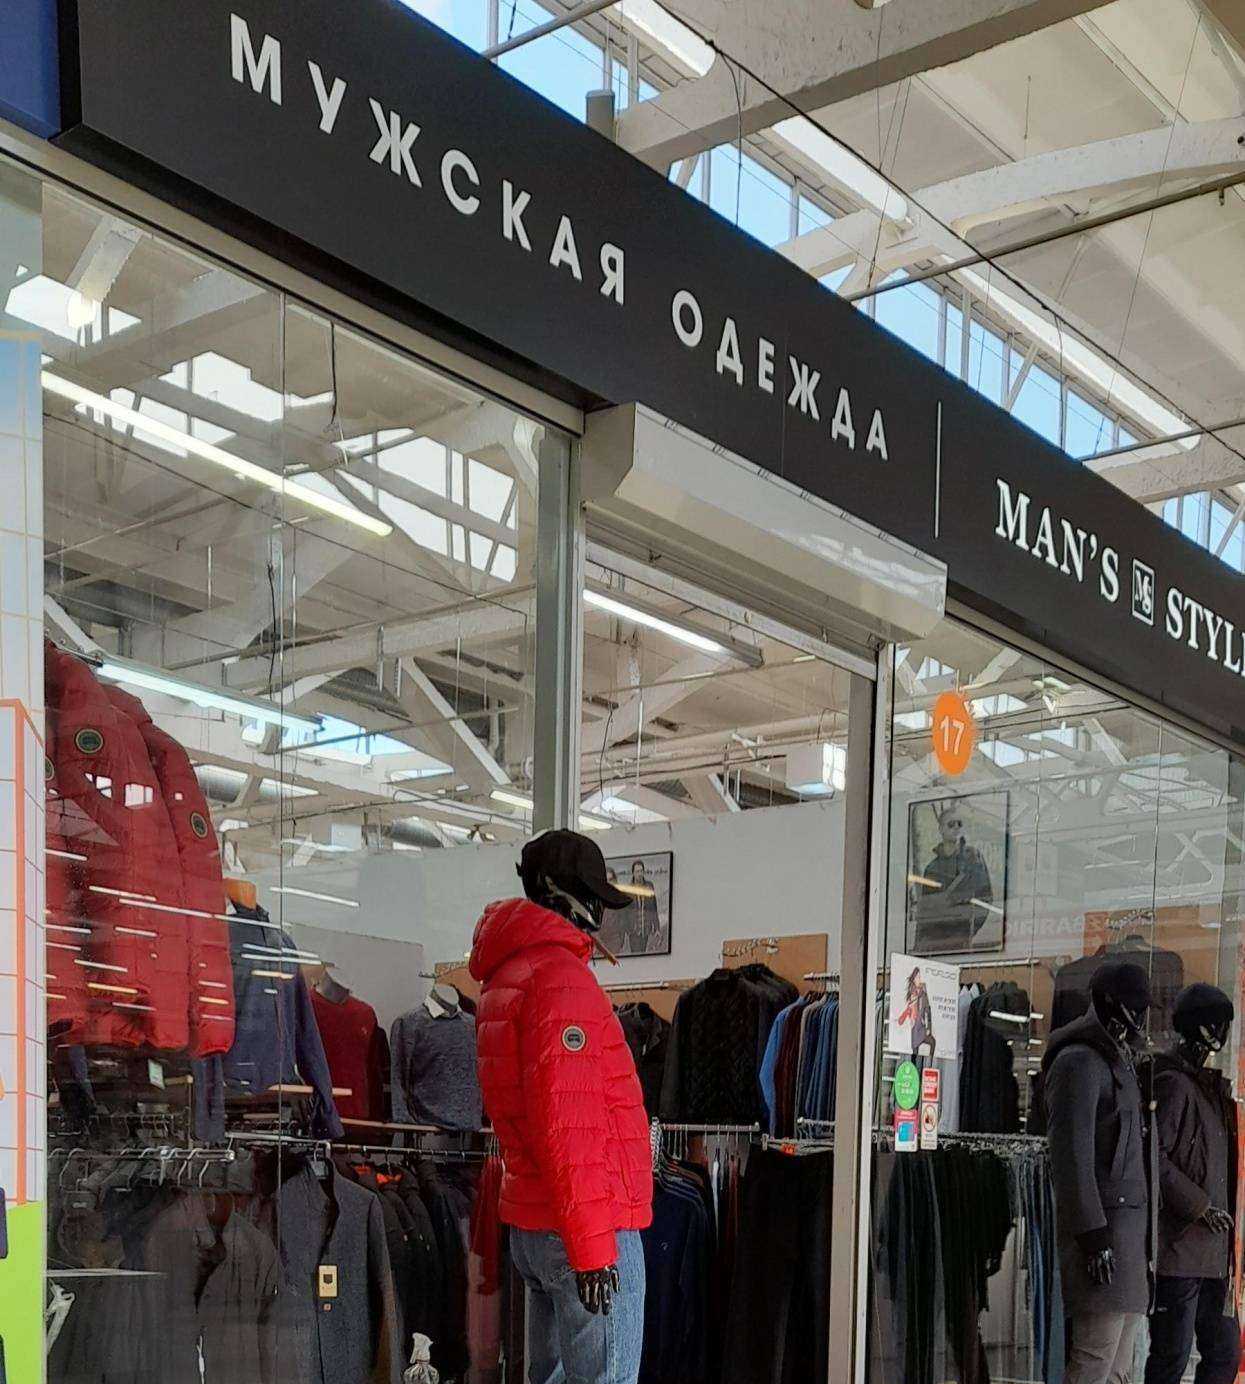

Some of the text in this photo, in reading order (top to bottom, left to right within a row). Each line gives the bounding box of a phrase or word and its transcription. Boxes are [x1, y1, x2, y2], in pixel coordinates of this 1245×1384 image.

[229, 13, 888, 460] МУЖСКАЯ ОДЕЖДА
[995, 478, 1120, 602] MAN'S
[1166, 587, 1245, 678] STYL
[940, 715, 964, 755] 17
